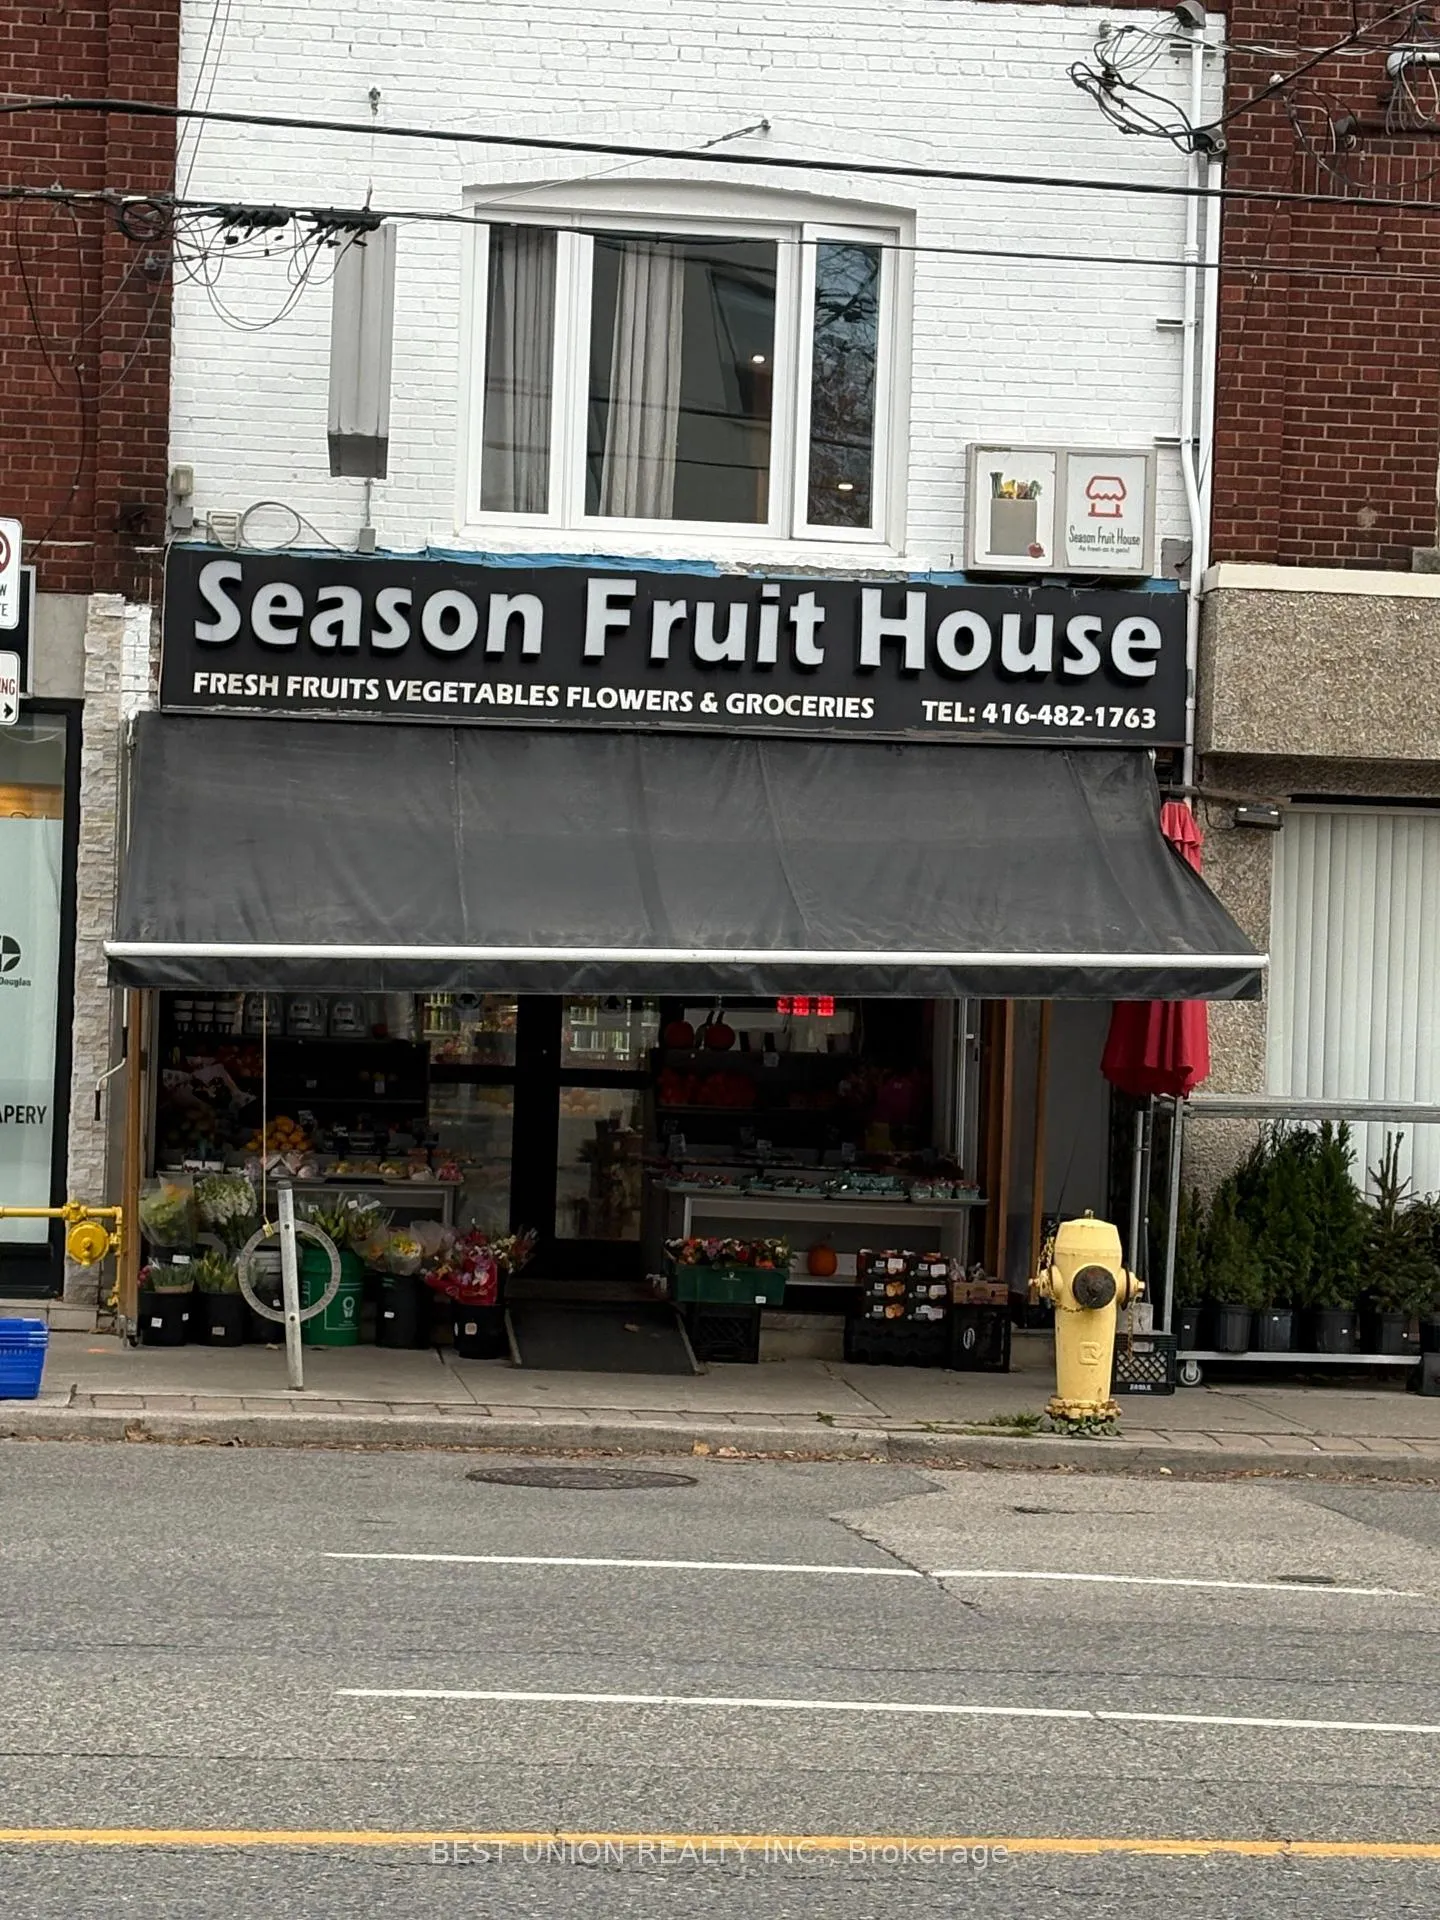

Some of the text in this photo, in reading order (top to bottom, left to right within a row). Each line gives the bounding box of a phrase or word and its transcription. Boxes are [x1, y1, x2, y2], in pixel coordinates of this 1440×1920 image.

[1068, 525, 1140, 546] Season Fruit House
[194, 559, 1162, 678] Season Fruit House
[193, 671, 1157, 729] FRESH FRUITS VEGETABLES FLOWERS & GROCERIES TEL: 416-482-1763
[0, 1104, 47, 1124] PERY
